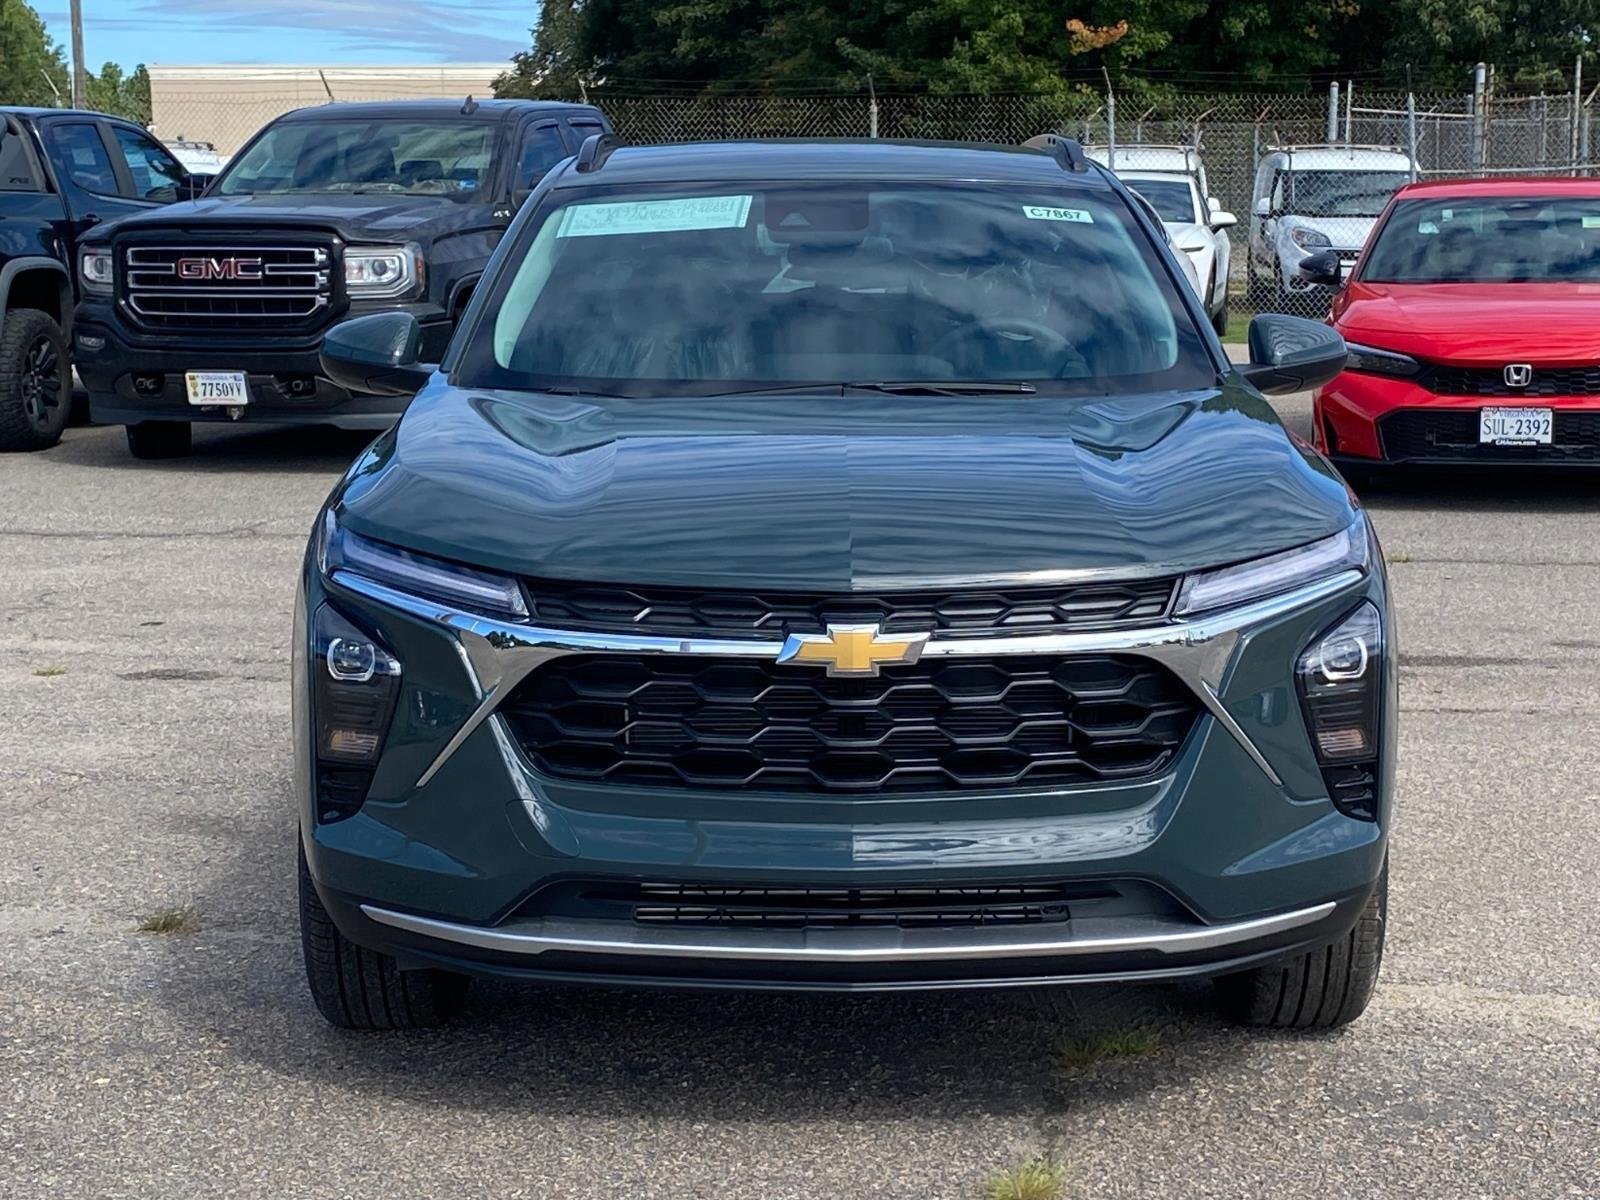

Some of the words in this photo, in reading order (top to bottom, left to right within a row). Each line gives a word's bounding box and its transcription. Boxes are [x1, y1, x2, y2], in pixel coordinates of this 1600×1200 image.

[1030, 208, 1080, 220] C7867
[178, 257, 262, 279] GMC
[1483, 418, 1550, 435] SUL-2392
